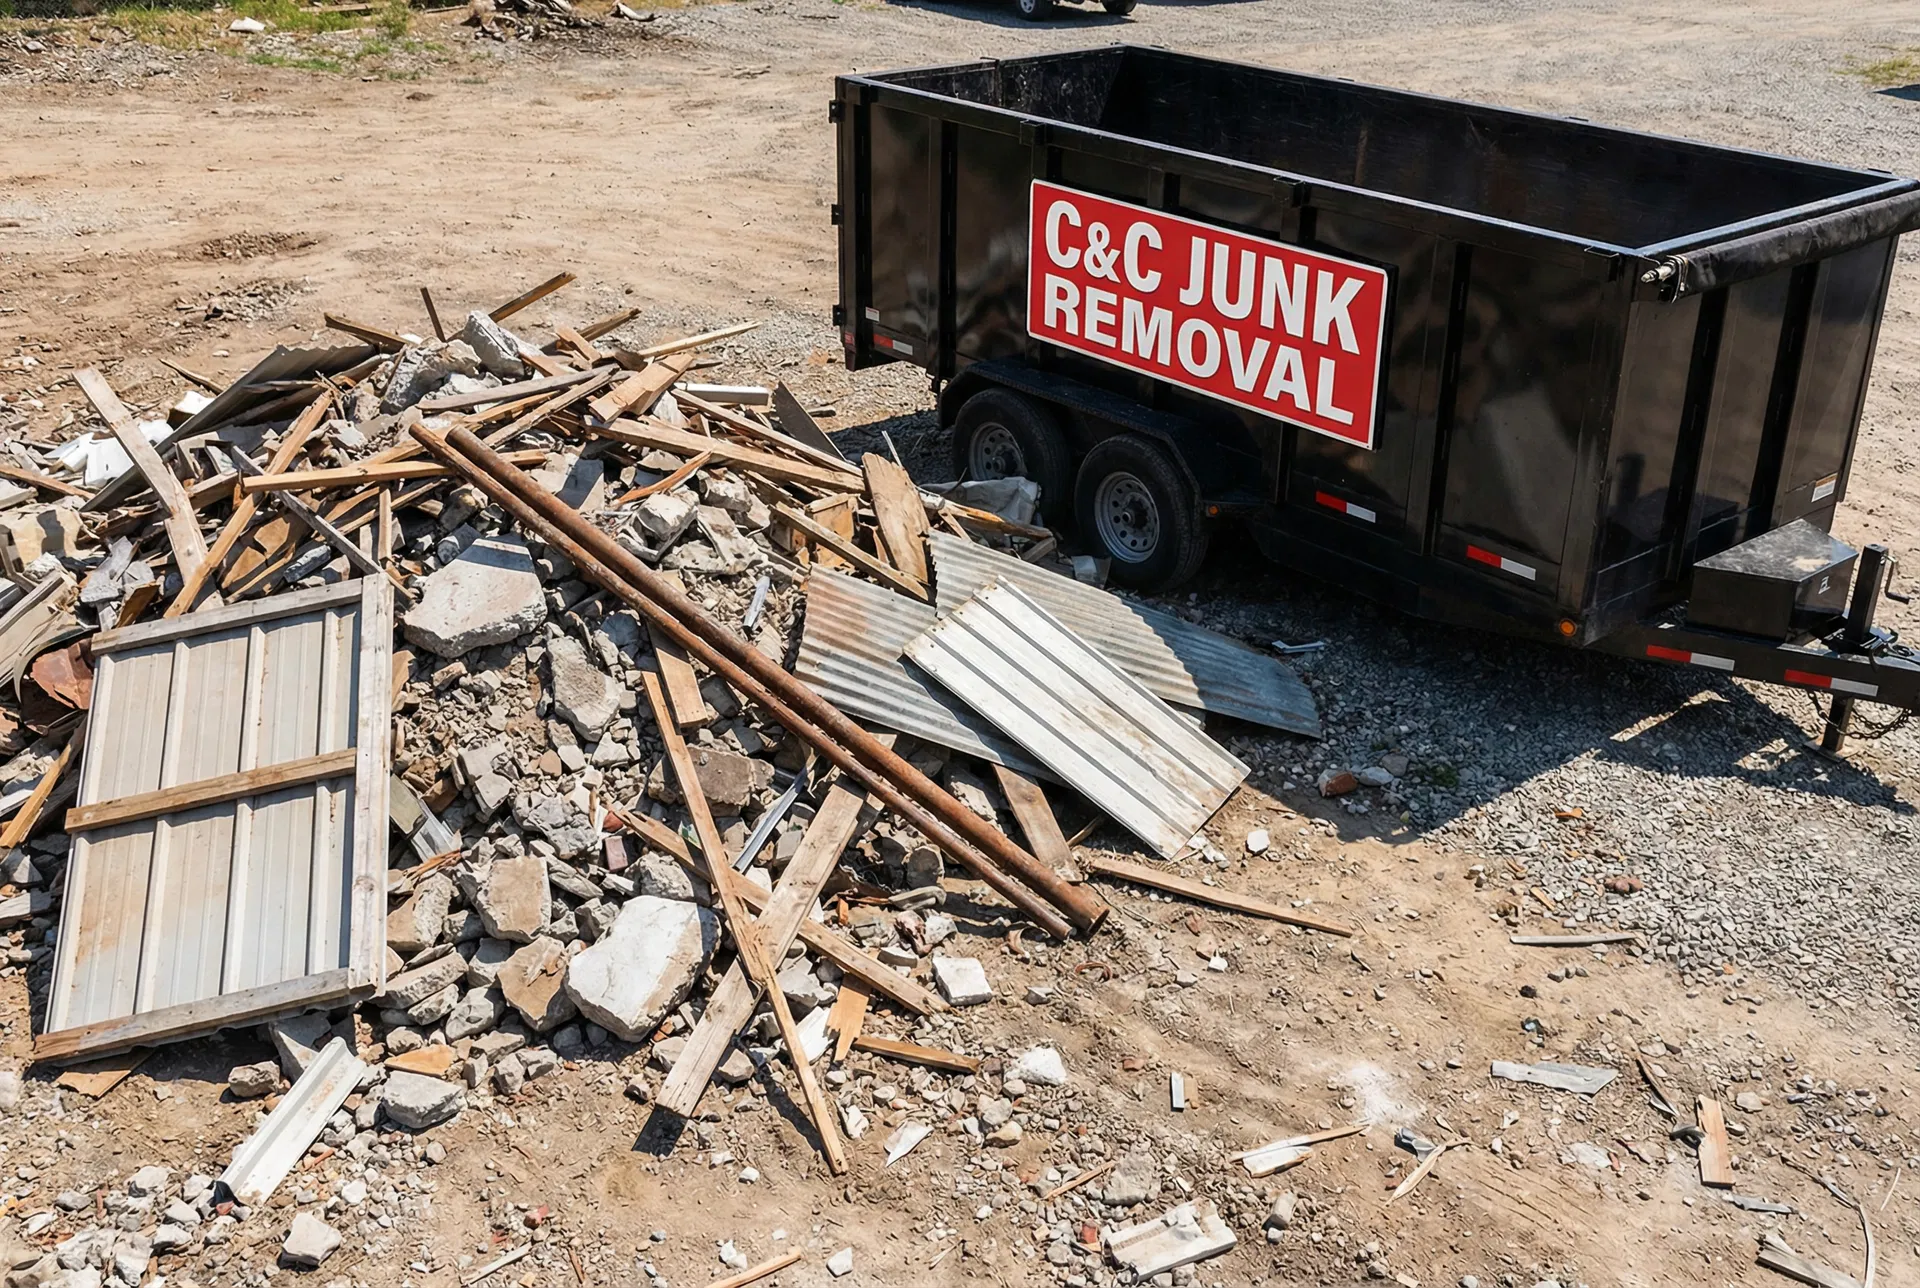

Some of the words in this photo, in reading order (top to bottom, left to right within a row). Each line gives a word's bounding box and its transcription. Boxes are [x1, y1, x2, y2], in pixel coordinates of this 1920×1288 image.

[1044, 273, 1354, 425] REMOVAL
[1045, 200, 1163, 293] C&C
[1180, 235, 1365, 355] JUNK
